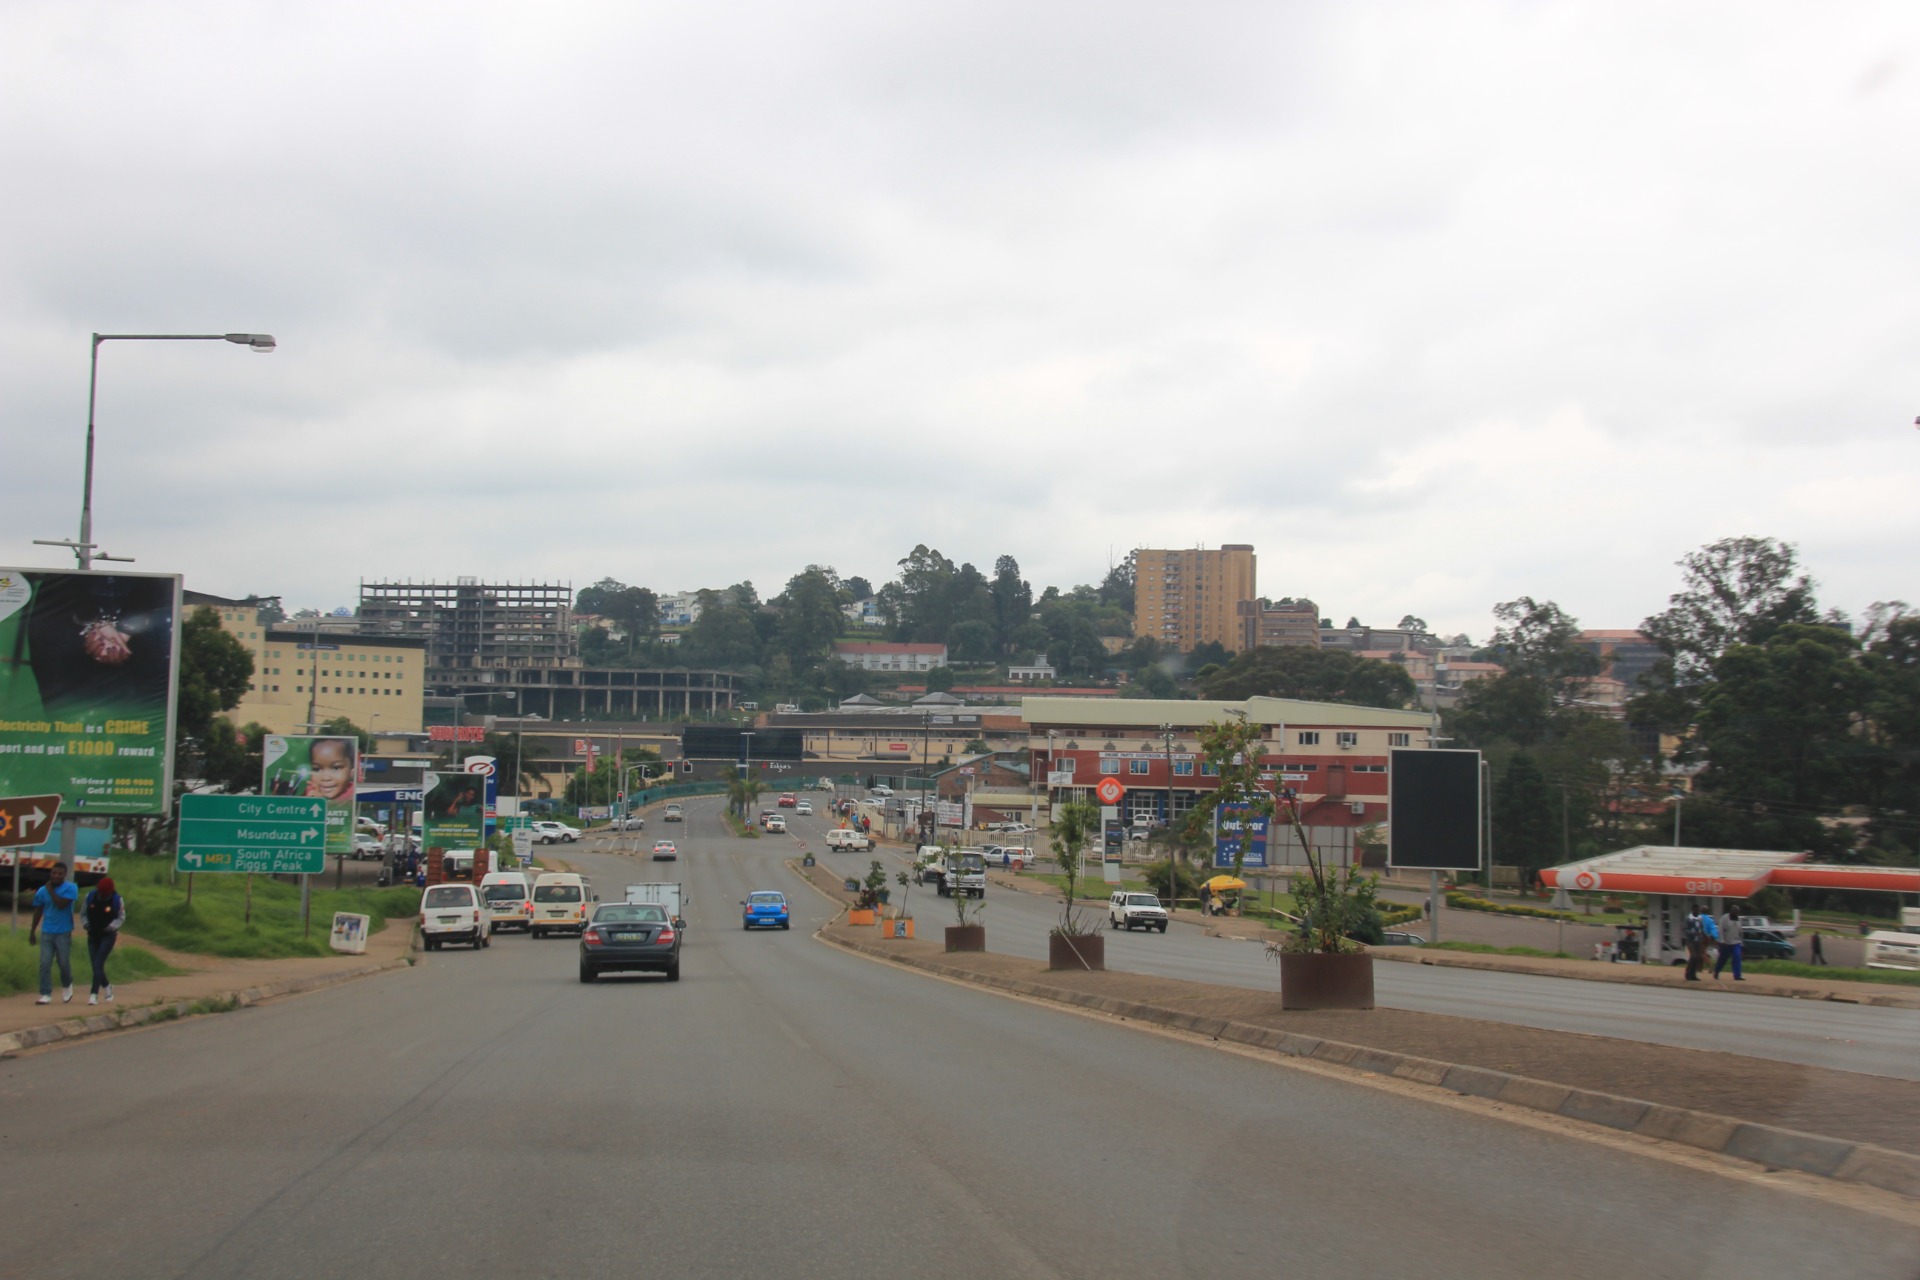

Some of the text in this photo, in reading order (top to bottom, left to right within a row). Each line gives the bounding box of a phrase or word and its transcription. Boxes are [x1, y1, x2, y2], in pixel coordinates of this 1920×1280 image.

[54, 721, 83, 733] Theft
[86, 724, 95, 733] is
[105, 720, 149, 735] CRIME
[24, 744, 44, 754] and
[47, 745, 65, 755] get
[68, 740, 114, 756] E1000
[118, 747, 155, 757] reward
[238, 803, 307, 816] City Centre
[237, 829, 297, 840] Msunduza
[205, 853, 232, 865] MR3
[237, 849, 312, 860] South Africa
[235, 860, 303, 872] Piggs Peak
[1685, 879, 1724, 894] galp
